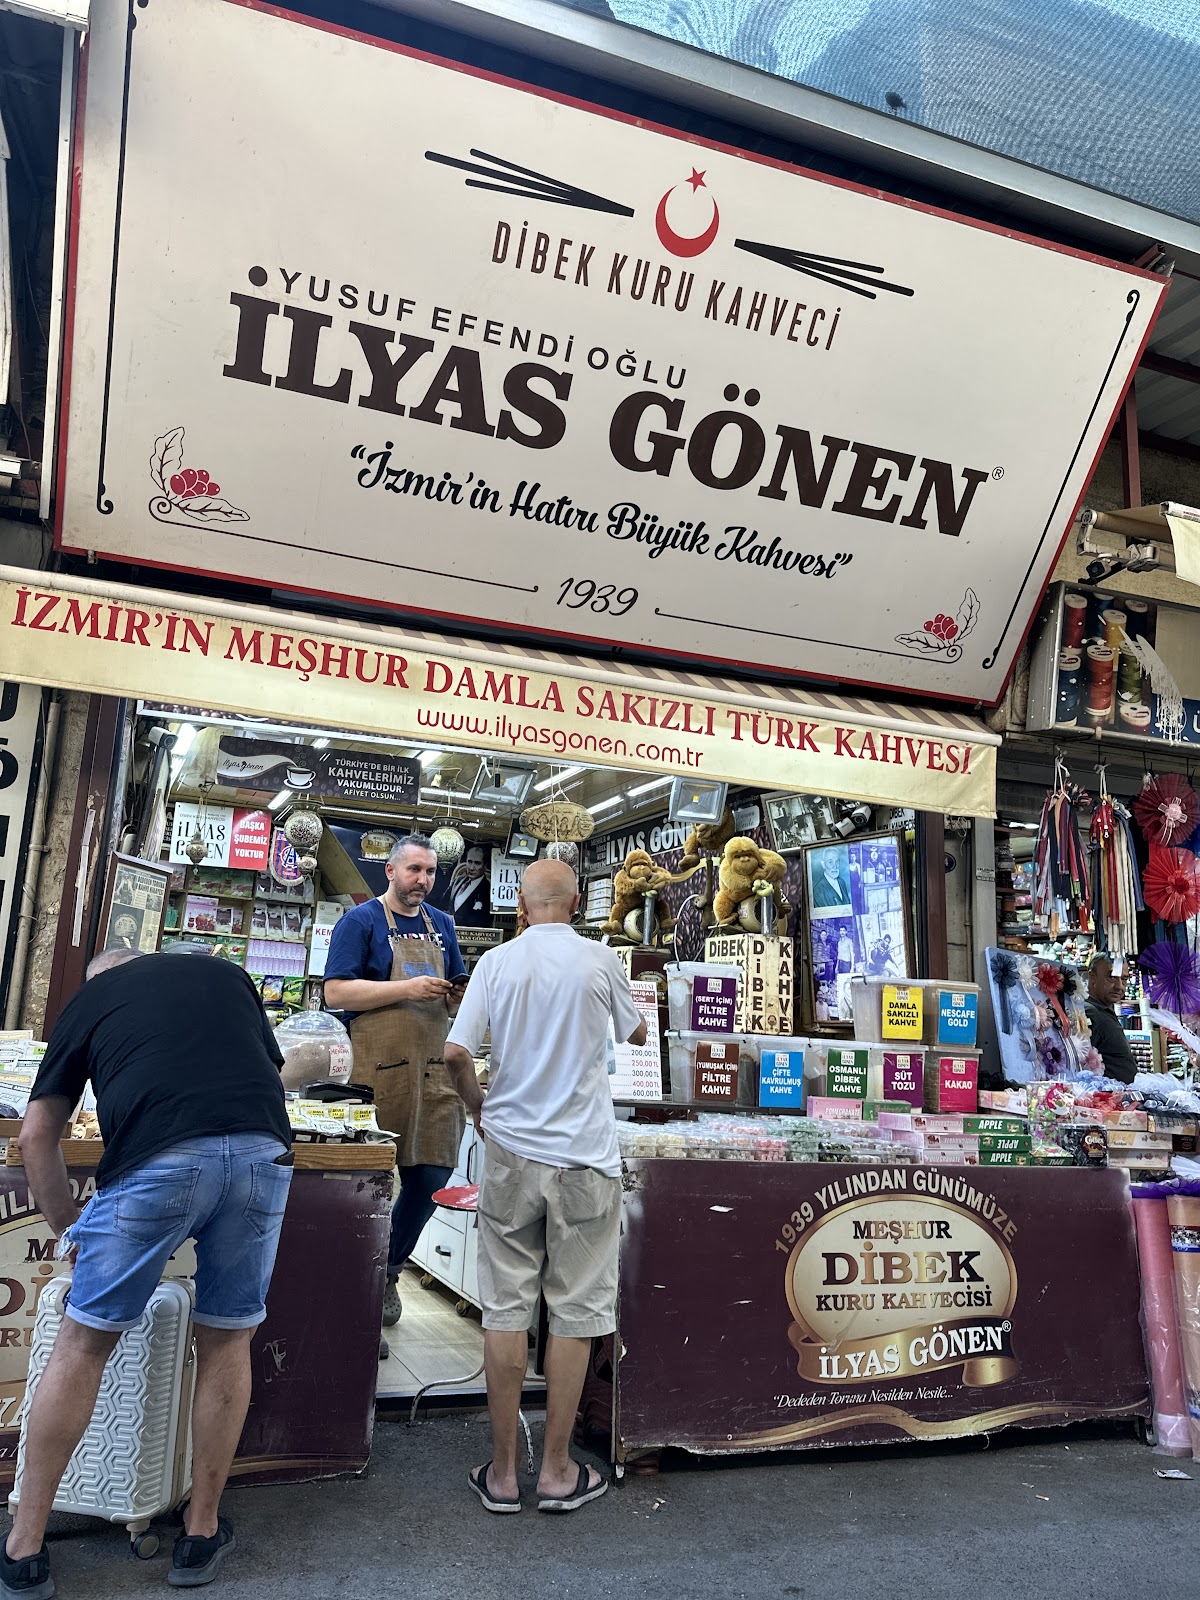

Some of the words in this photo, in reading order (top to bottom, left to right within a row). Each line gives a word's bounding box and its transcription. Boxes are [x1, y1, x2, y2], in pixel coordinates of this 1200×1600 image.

[491, 220, 590, 288] DİBEK
[608, 253, 694, 313] KURU
[704, 282, 841, 352] KAHVECİ
[277, 266, 417, 322] YUSUF
[431, 304, 574, 363] EFENDİ
[587, 346, 687, 390] OĞLU
[222, 266, 574, 450] İLYAS
[608, 383, 988, 537] GÖNEN
[607, 501, 711, 559] Büyük
[714, 521, 853, 581] Kahvesi”
[556, 577, 640, 616] 1939
[10, 585, 216, 658] İZMİR’İN
[223, 625, 410, 690] MEŞHUR
[423, 660, 564, 714] DAMLA
[576, 685, 716, 738] SAKIZLI
[726, 708, 821, 754] TÜRK
[833, 727, 972, 776] KAHVESİ
[417, 707, 704, 768] www.ilyasgonen.com.tr
[382, 763, 396, 772] BİR
[396, 764, 410, 774] İLK
[328, 767, 414, 786] KAHVELERİMİZ
[337, 778, 405, 794] VAKUMLUDUR.
[344, 789, 370, 800] AFİYET
[239, 820, 265, 833] BAŞKA
[234, 834, 268, 846] ŞUBEMİZ
[235, 848, 265, 859] YOKTUR
[710, 938, 745, 957] DİBEK
[778, 942, 792, 1034] KAHVE
[716, 996, 733, 1006] İÇİM)
[889, 1001, 917, 1010] DAMLA
[699, 1004, 728, 1015] FİLTRE
[886, 1010, 919, 1018] SAKIZLI
[941, 1009, 976, 1019] NESCAFE
[698, 1017, 728, 1028] KAHVE
[888, 1018, 917, 1027] KAHVE
[947, 1018, 968, 1027] GOLD
[632, 1050, 652, 1058] 200,00
[632, 1060, 652, 1068] 250,00
[697, 1062, 724, 1071] (YUMUŞAK
[632, 1070, 653, 1078] 300,00
[772, 1068, 791, 1077] ÇİFTE
[829, 1066, 867, 1075] OSMANLI
[894, 1071, 912, 1081] SÜT
[702, 1072, 731, 1083] FİLTRE
[761, 1077, 801, 1087] KAVRULMUŞ
[835, 1074, 861, 1084] DİBEK
[701, 1085, 731, 1095] KAHVE
[770, 1086, 792, 1094] KAHVE
[832, 1083, 862, 1093] KAHVE
[891, 1081, 916, 1090] TOZU
[944, 1080, 973, 1090] KAKAO
[632, 1090, 653, 1098] 600,00
[978, 1120, 1003, 1129] APPLE
[997, 1139, 1019, 1149] APPLE
[990, 1153, 1012, 1163] APPLE
[775, 1201, 815, 1254] 1939
[814, 1168, 907, 1211] YILINDAN
[912, 1167, 1019, 1244] GÜNÜMÜZE
[853, 1220, 952, 1245] MEŞHUR
[821, 1241, 984, 1286] DİBEK
[816, 1293, 876, 1312] KURU
[882, 1284, 993, 1310] KAHVECİSİ
[819, 1347, 900, 1379] İLYAS
[909, 1324, 1003, 1367] GÖNEN
[868, 1389, 913, 1403] Nesilden
